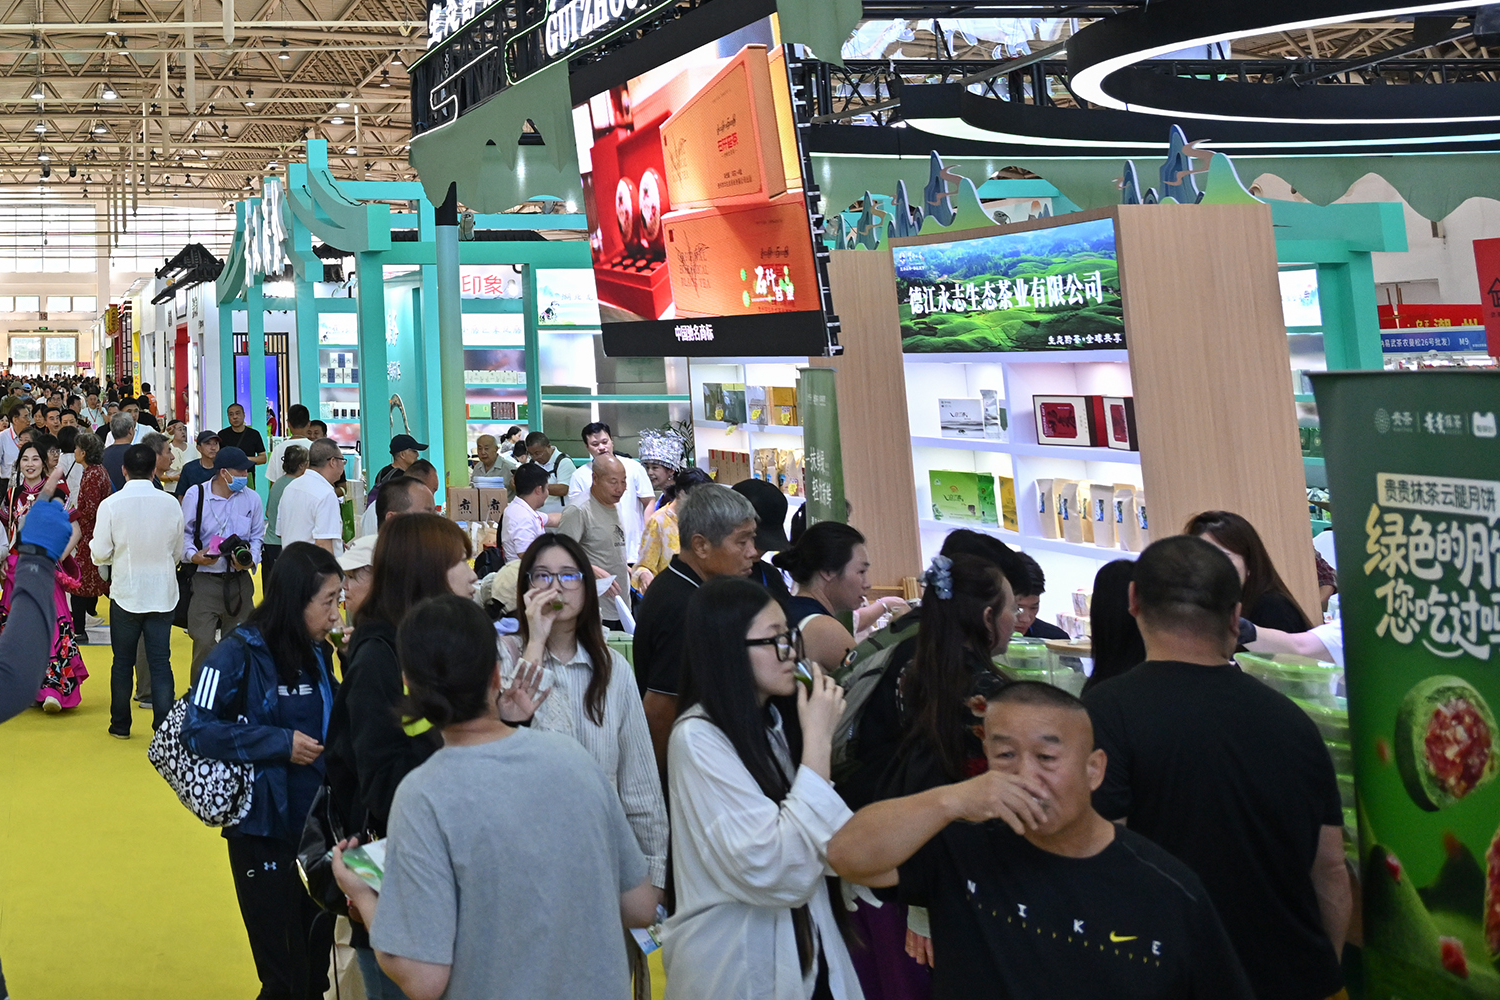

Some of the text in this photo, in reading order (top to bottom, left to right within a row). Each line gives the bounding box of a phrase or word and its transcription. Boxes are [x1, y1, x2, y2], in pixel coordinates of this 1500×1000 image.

[462, 275, 503, 294] 印象
[909, 270, 1104, 314] 德江永志生态茶业有限公司
[460, 498, 472, 514] 煮
[1384, 479, 1496, 512] 贵贵抹茶云腿月饼
